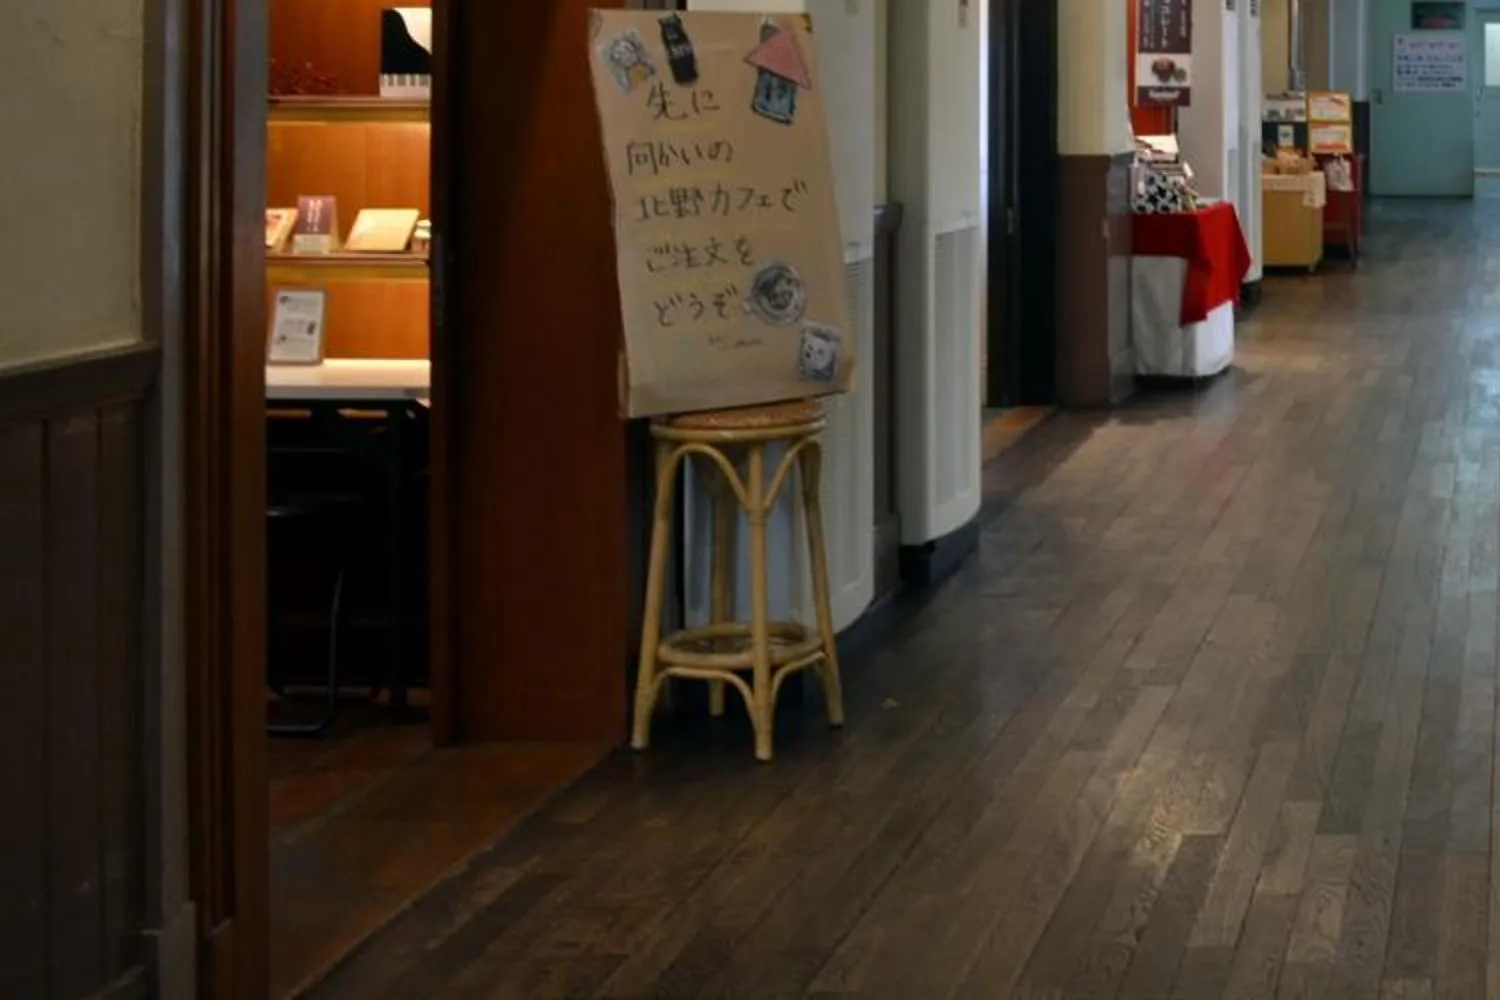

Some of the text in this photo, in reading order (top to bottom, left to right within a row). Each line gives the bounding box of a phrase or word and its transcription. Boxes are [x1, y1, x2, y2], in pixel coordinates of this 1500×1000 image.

[645, 81, 721, 121] 先に
[626, 140, 735, 176] 向かいの
[636, 180, 810, 223] 北野カフェで
[644, 236, 756, 272] ご注文を
[653, 288, 740, 327] どうぞ
